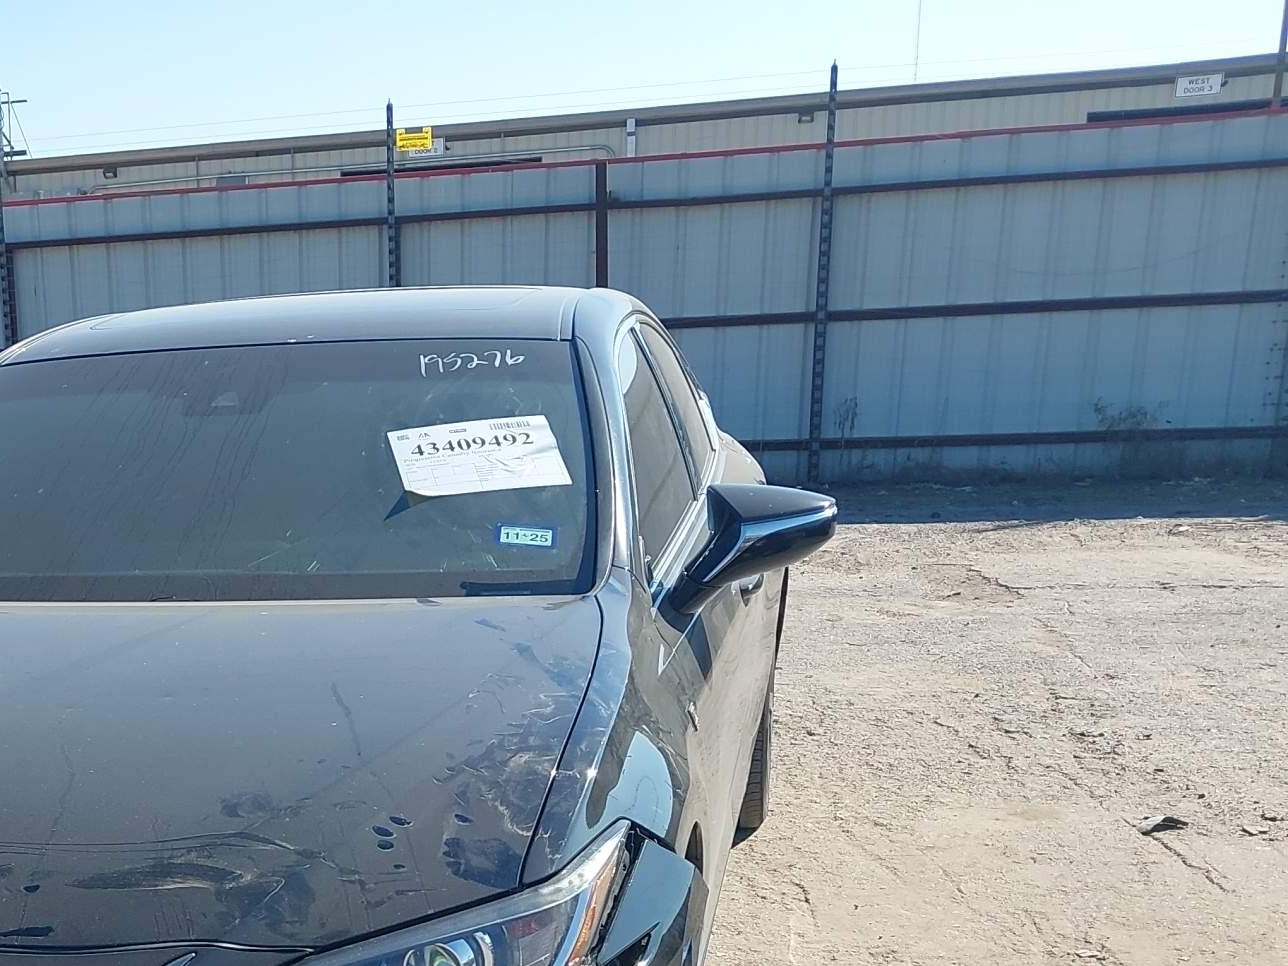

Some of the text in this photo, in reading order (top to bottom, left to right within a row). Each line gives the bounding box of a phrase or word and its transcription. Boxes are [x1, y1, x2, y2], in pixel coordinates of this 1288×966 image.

[1188, 77, 1210, 85] WEST
[1183, 86, 1205, 94] DOOR
[411, 432, 534, 457] 43409492
